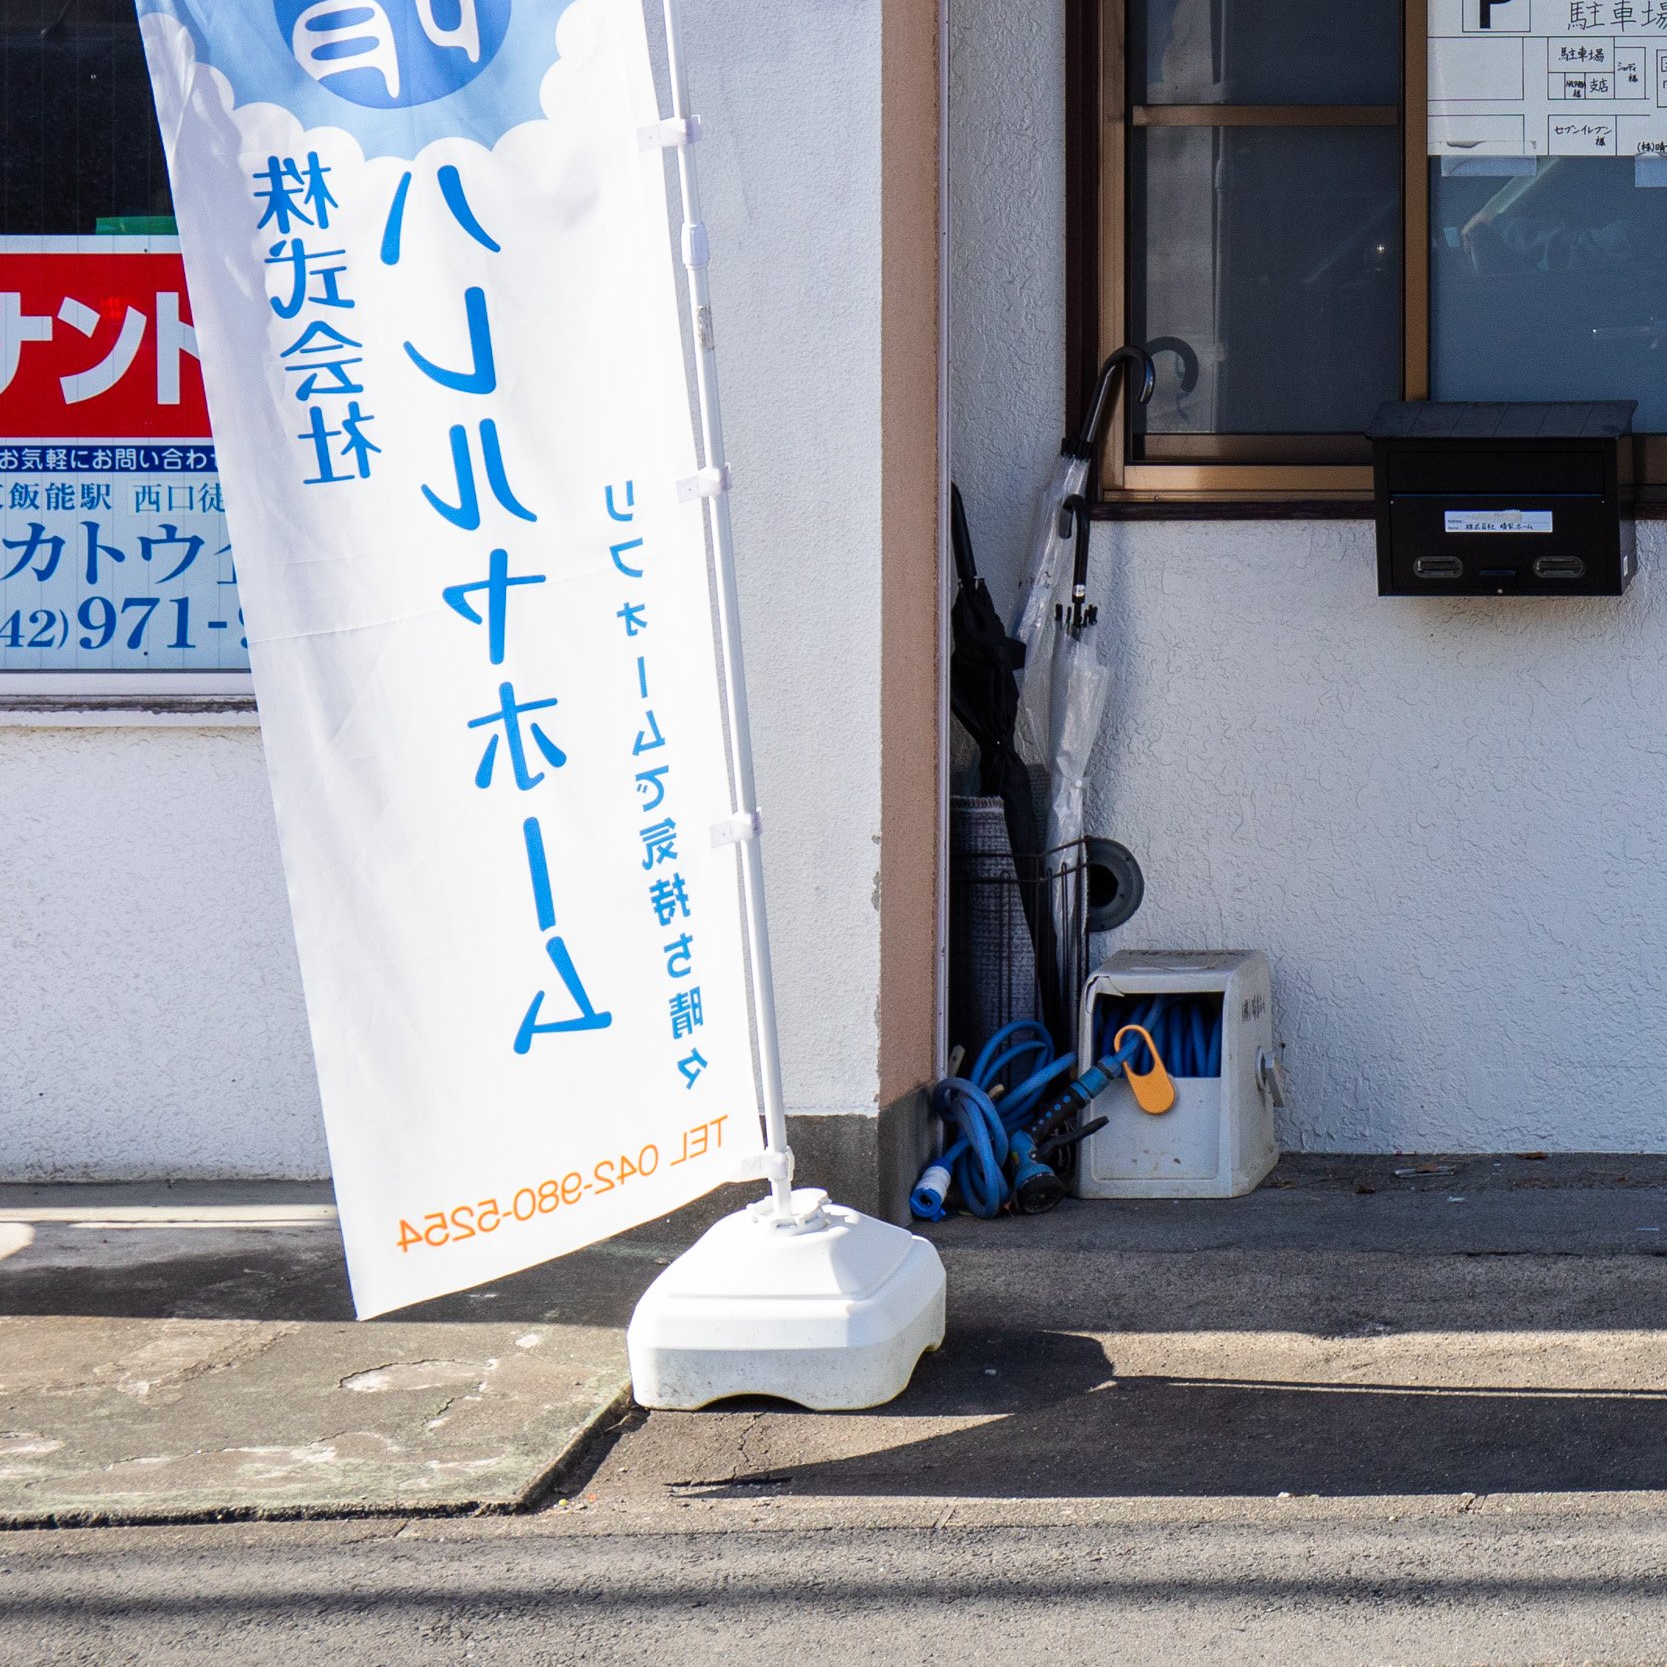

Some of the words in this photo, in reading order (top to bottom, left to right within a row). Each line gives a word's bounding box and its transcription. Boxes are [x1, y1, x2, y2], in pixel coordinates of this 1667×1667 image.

[1558, 46, 1605, 63] 駐車場
[1554, 124, 1613, 136] セブンイレブン
[0, 448, 216, 471] お気軽にお問い合わ
[0, 482, 112, 511] 飯能駅
